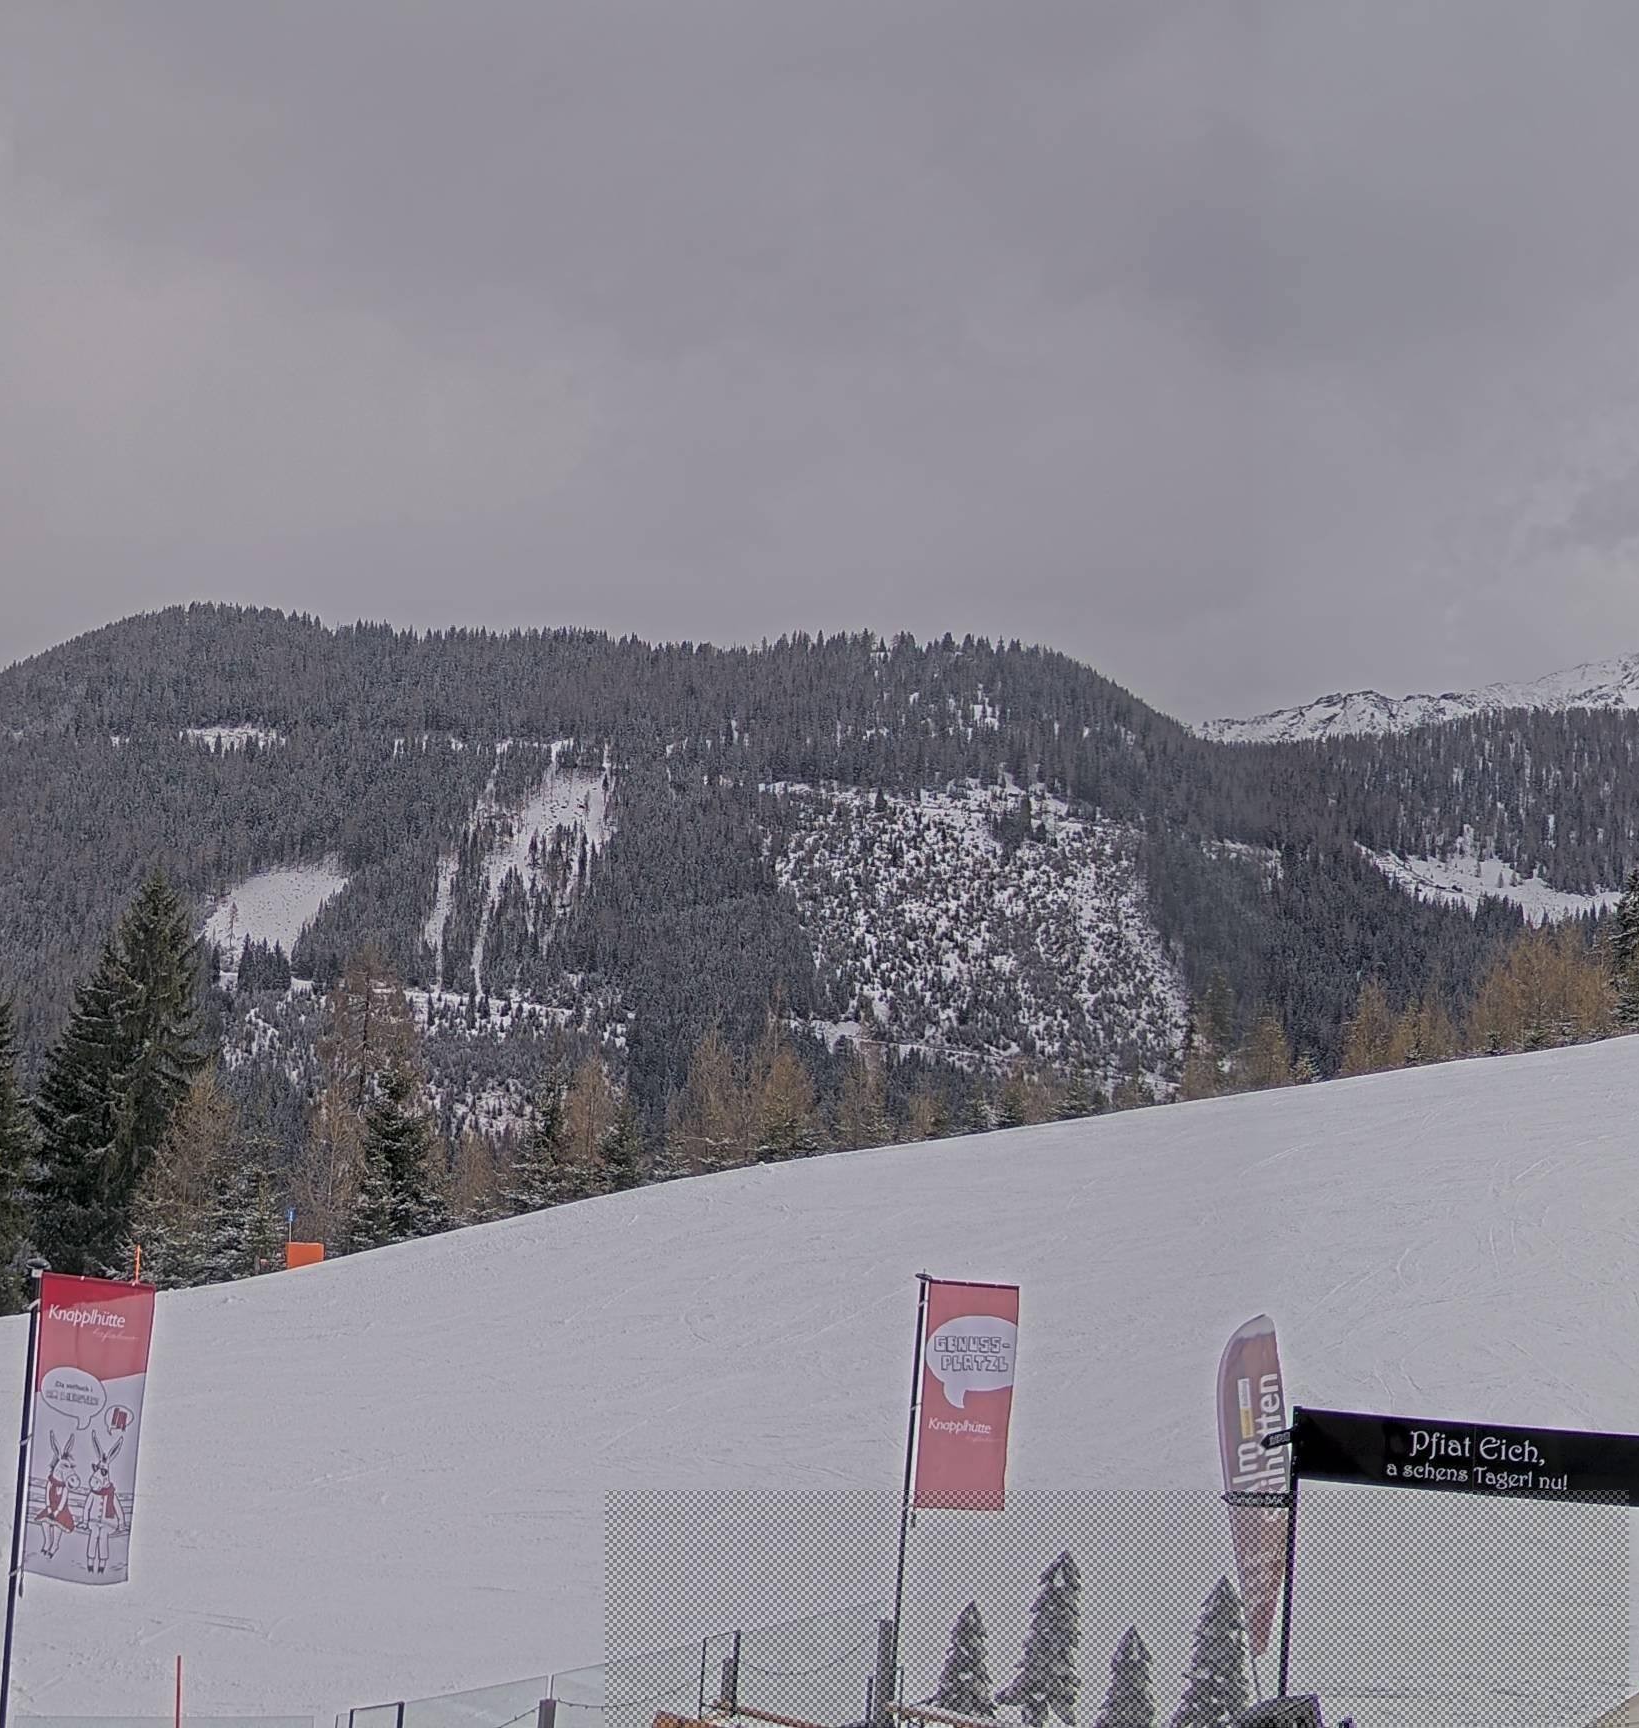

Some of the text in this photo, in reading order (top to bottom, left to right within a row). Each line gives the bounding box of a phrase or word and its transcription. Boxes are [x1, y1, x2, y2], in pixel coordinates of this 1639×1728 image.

[48, 1304, 126, 1328] Knapplhütte
[934, 1336, 1011, 1353] GENUSS-
[941, 1354, 1009, 1372] PLATZL
[928, 1417, 992, 1435] Knapplhütte
[1409, 1430, 1546, 1467] Pfiat Eich,
[1386, 1462, 1568, 1491] a schens Tagerl nu!
